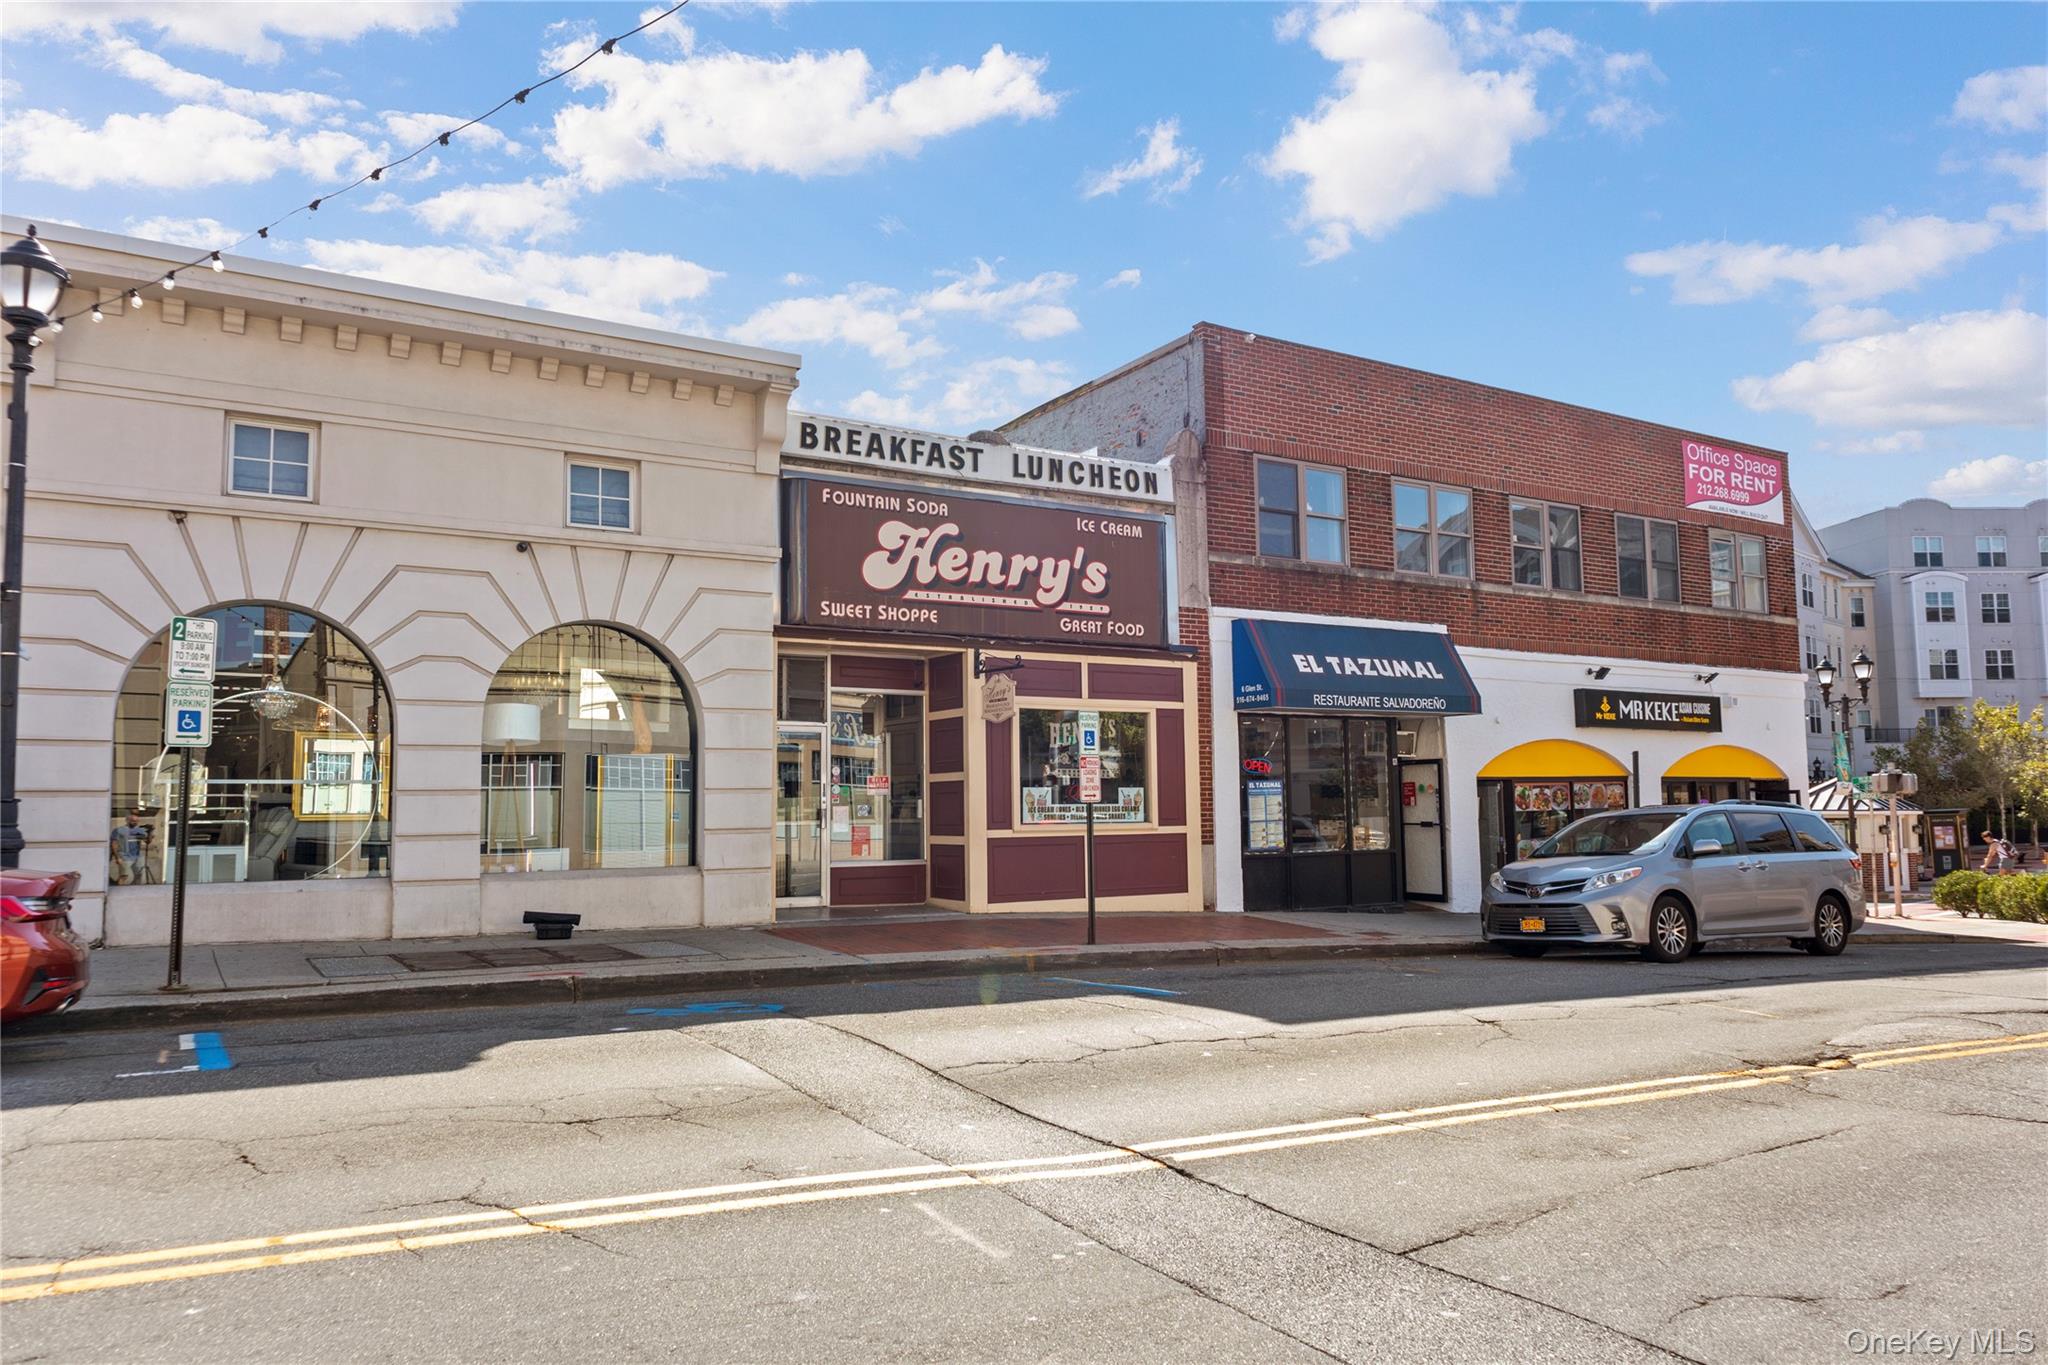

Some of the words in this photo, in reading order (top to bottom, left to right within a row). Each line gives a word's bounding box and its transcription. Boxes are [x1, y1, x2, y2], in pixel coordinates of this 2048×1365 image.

[800, 421, 984, 472] BREAKFAST
[1012, 453, 1159, 495] LUNCHEON
[1687, 443, 1730, 467] Office
[1734, 453, 1777, 477] Space
[1688, 463, 1726, 485] FOR
[1731, 472, 1776, 495] RENT
[822, 487, 900, 512] FOUNTAIN
[906, 498, 949, 517] SODA
[1697, 483, 1750, 503] 212.268.6999
[1076, 517, 1095, 533] ICE
[1100, 520, 1143, 538] CREAM
[862, 519, 1109, 605] Henry's
[914, 592, 1029, 606] ESTABLISHED
[820, 600, 872, 620] SWEET
[877, 604, 938, 623] SHOPPE
[175, 621, 185, 638] 2
[187, 630, 213, 641] PARKING
[1060, 617, 1103, 634] GREAT
[1107, 620, 1145, 637] FOOD
[175, 650, 185, 660] TO
[200, 652, 211, 662] PM
[195, 643, 206, 652] AM
[1292, 654, 1323, 674] EL
[1325, 656, 1444, 680] TAZUMAL
[170, 687, 209, 698] RESERVED
[172, 698, 207, 709] PARKING
[1313, 694, 1382, 709] RESTAURANTE
[1383, 697, 1447, 710] SALVADOREÑO
[1595, 712, 1603, 720] Mr
[1244, 759, 1272, 775] OPEN
